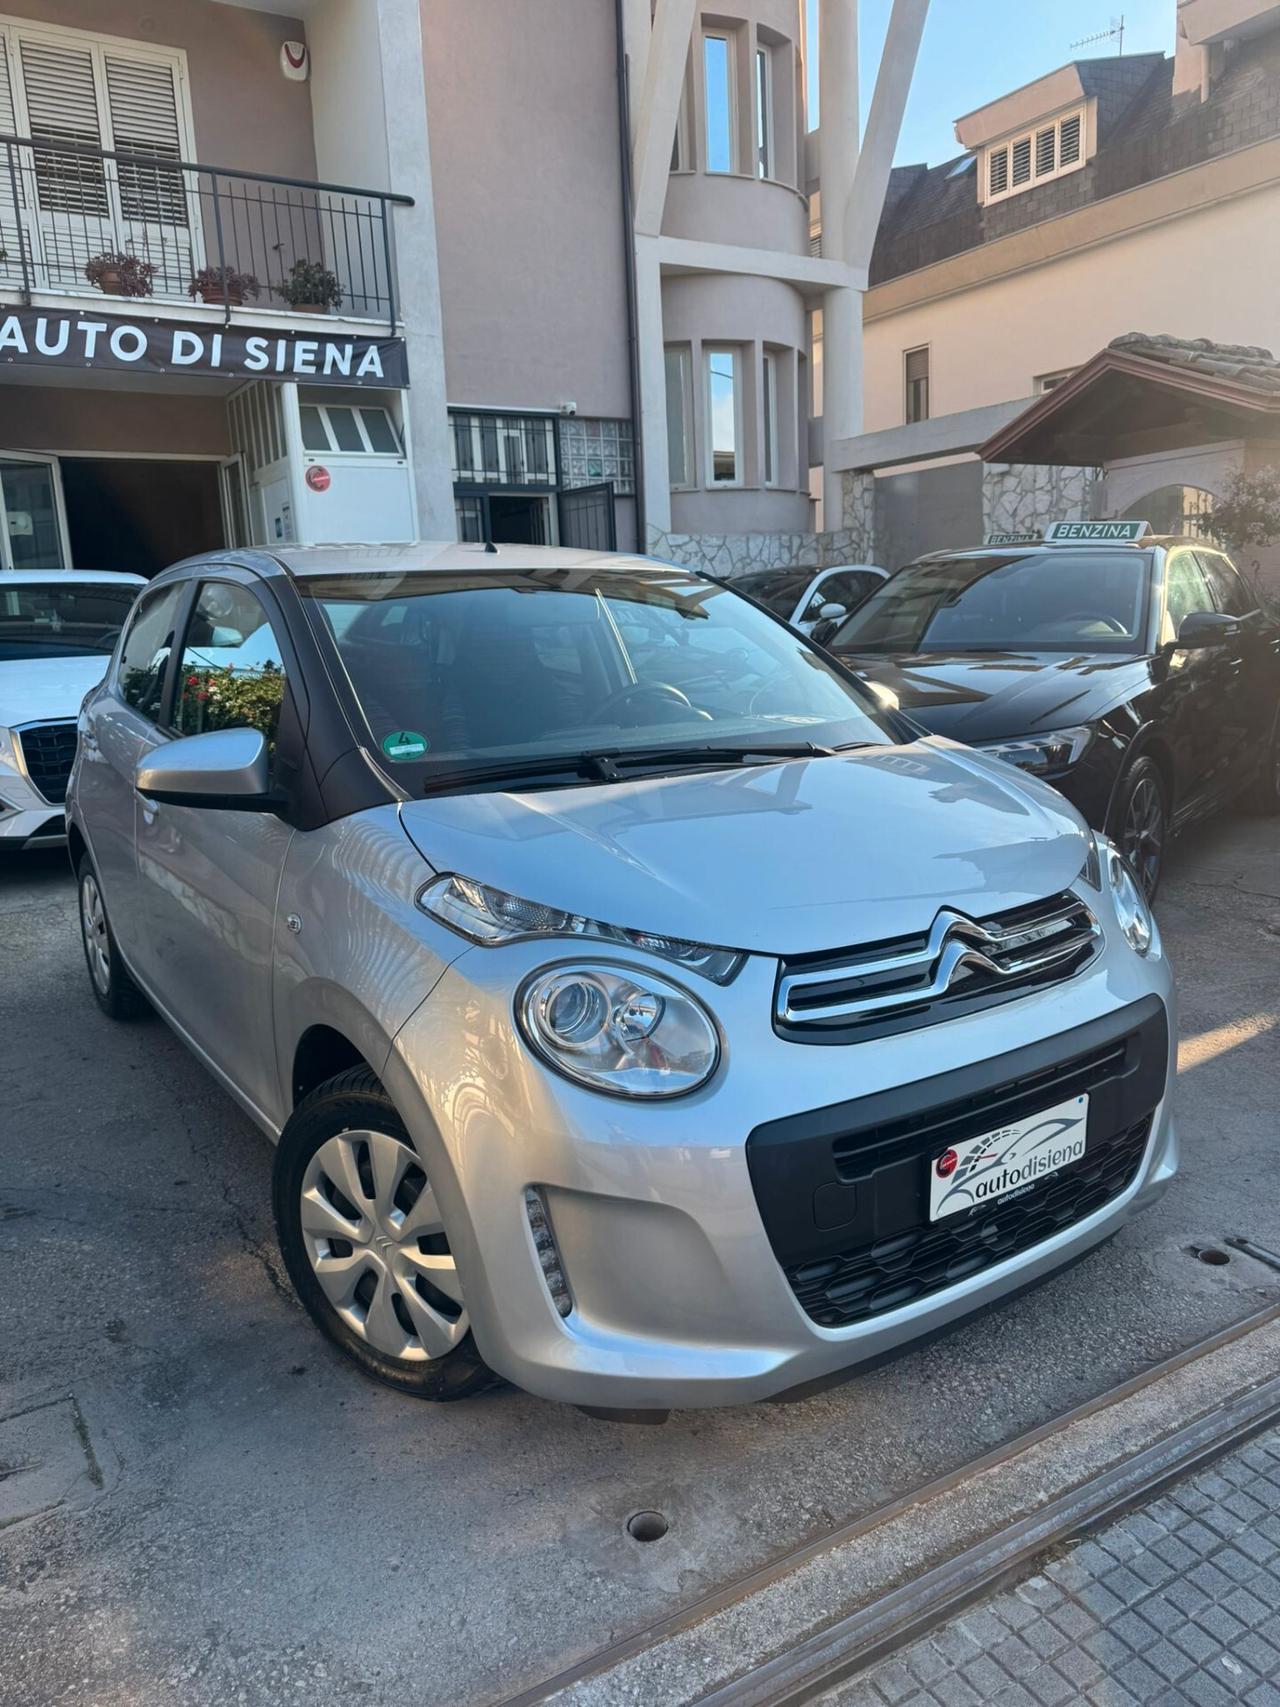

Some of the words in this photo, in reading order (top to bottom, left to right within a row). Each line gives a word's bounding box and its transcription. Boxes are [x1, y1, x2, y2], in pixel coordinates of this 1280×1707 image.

[0, 316, 148, 362] AUTO
[171, 331, 223, 367] DI
[243, 336, 384, 378] SIENA
[1057, 524, 1131, 538] BENZINA
[975, 1140, 1083, 1198] autodisiena
